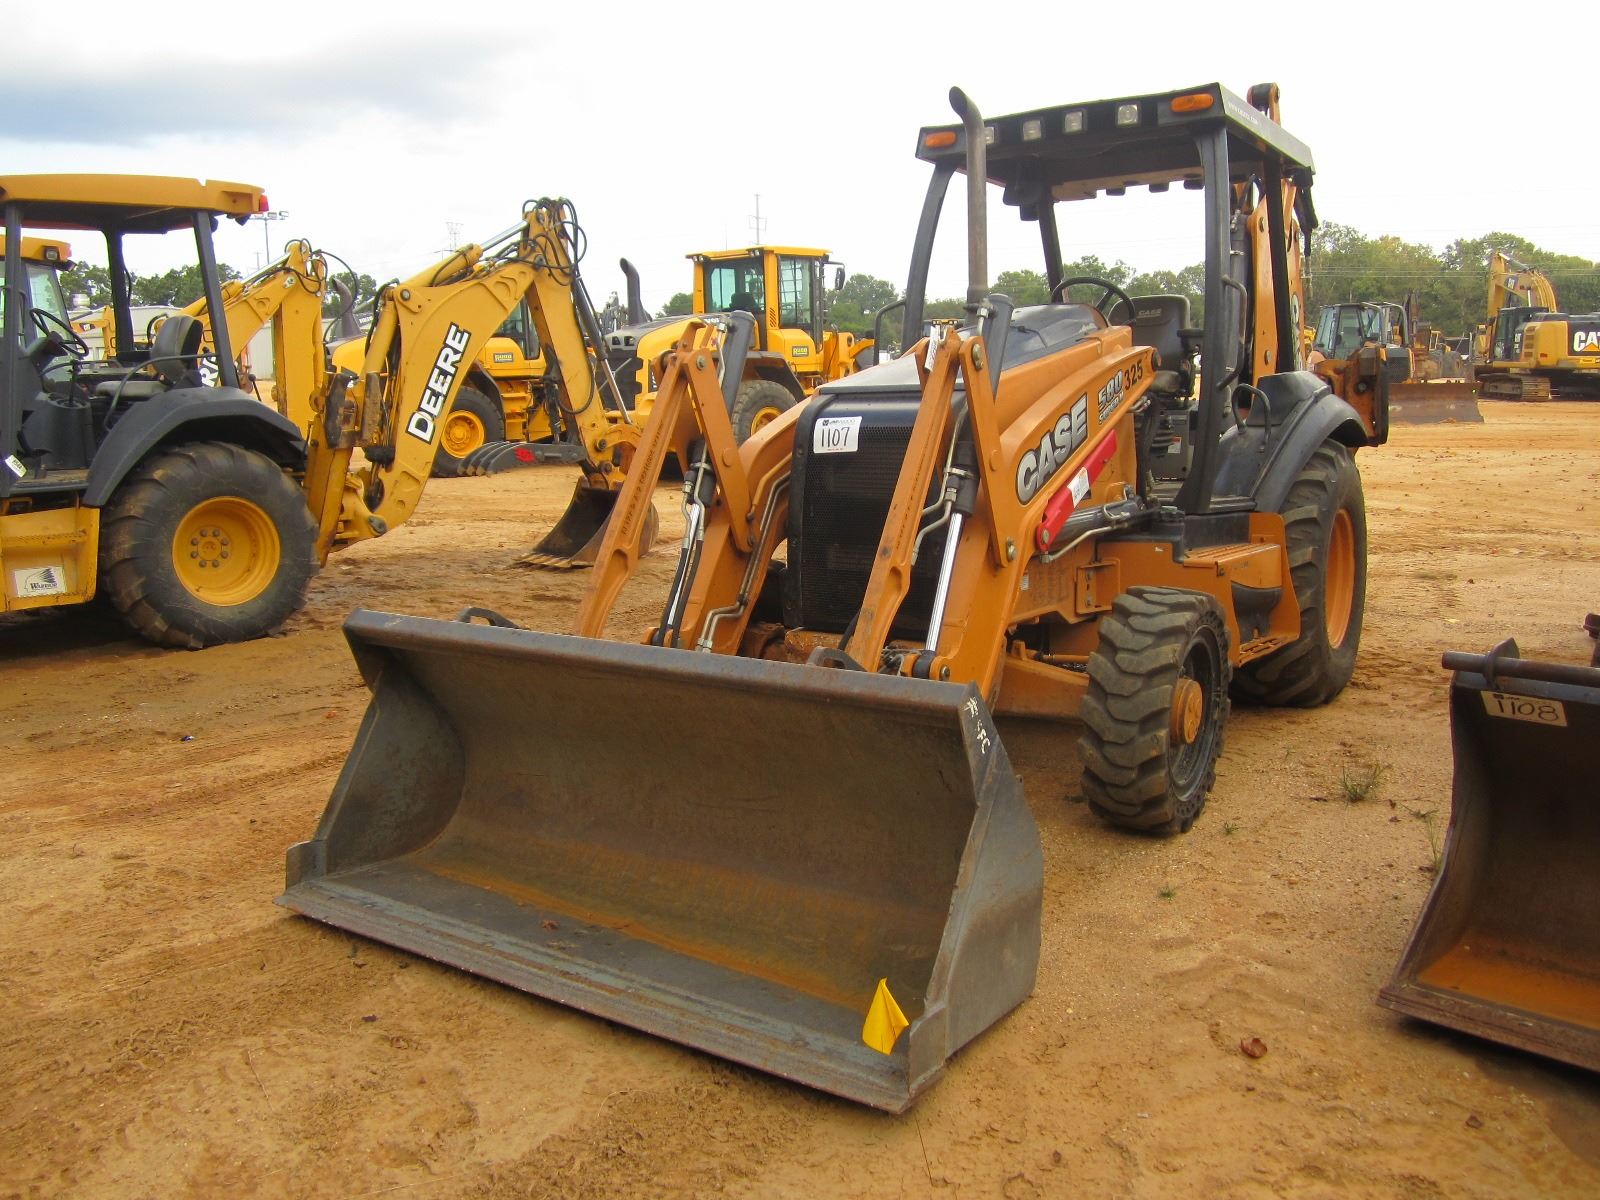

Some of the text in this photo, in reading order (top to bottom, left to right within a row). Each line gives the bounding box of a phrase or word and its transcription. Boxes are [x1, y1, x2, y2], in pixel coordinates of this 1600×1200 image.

[1573, 331, 1600, 352] CA
[407, 322, 471, 444] DEERE
[1098, 369, 1123, 406] 580
[1124, 359, 1143, 390] 325
[821, 426, 850, 448] 1107
[1016, 392, 1088, 505] CASE
[1498, 700, 1559, 721] 1108
